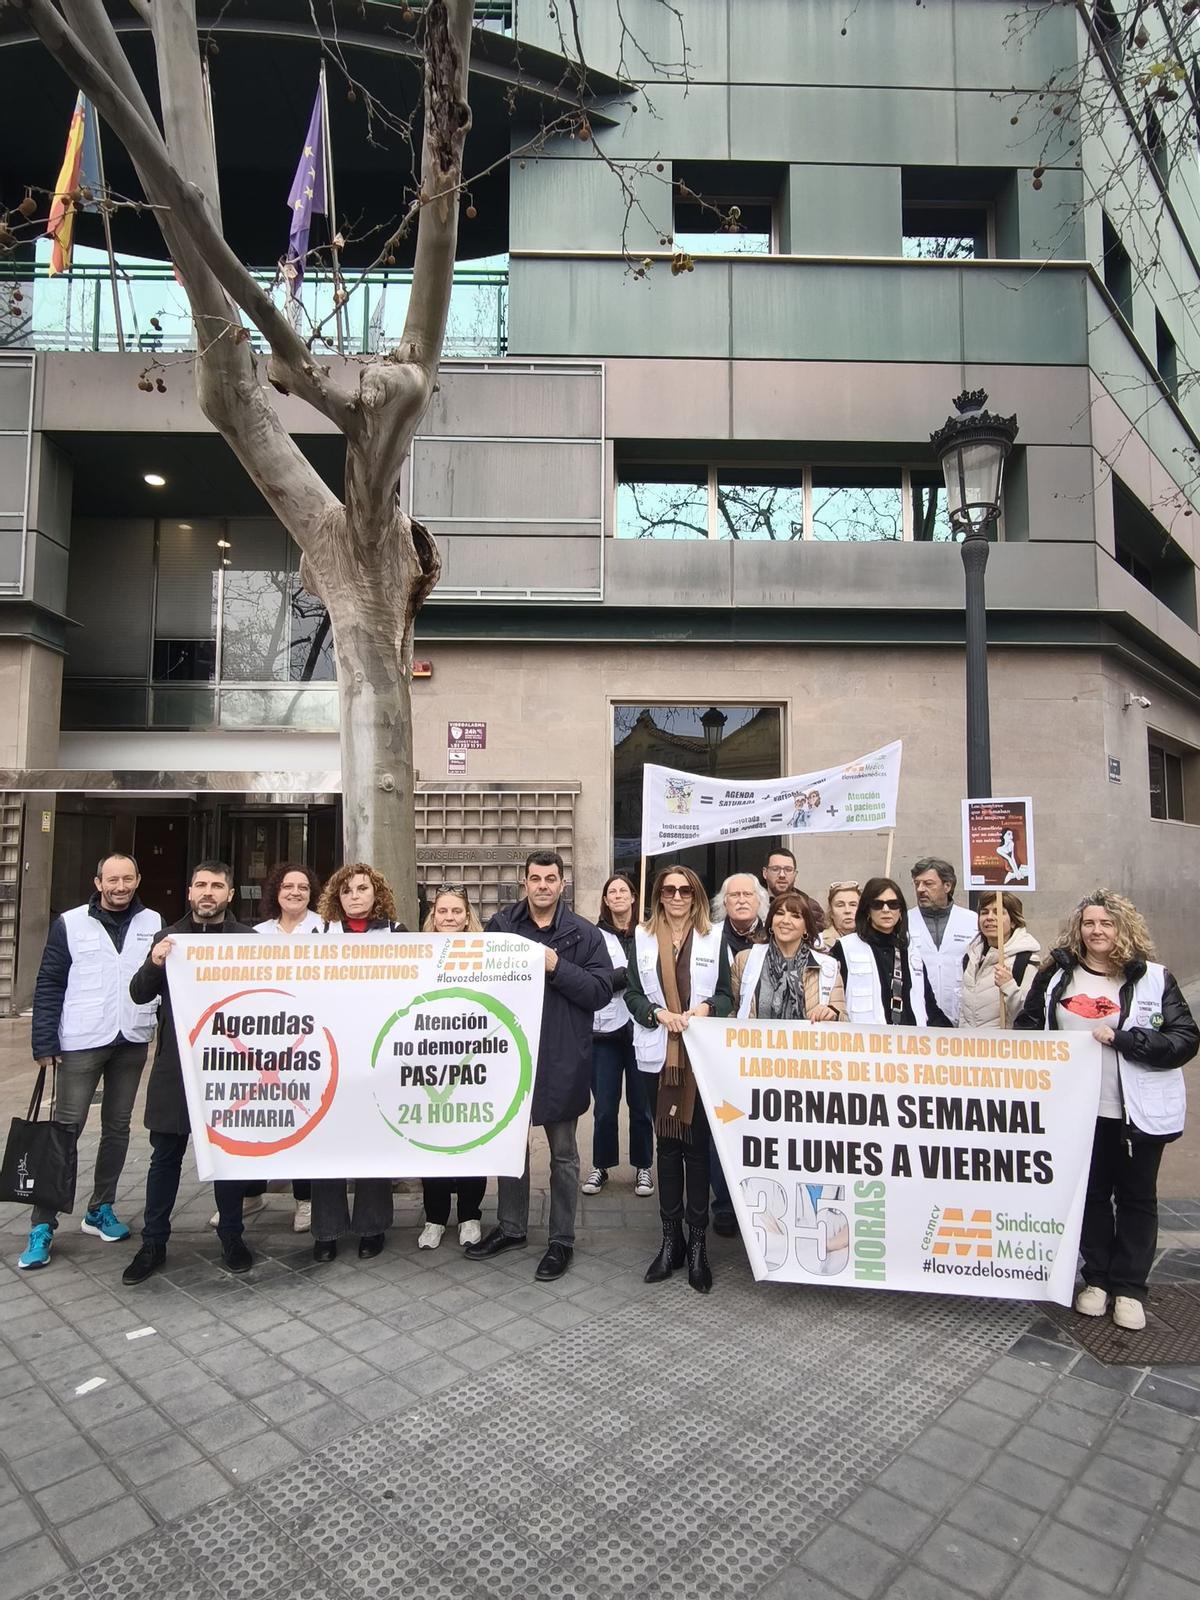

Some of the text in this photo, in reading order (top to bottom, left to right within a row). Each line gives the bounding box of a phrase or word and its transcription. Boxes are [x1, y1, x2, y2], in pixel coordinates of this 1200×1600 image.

[725, 790, 755, 799] AGENDA
[187, 943, 434, 961] POR LA MEJORA DE LAS CONDICIONES
[485, 939, 530, 953] Sindicato
[196, 964, 419, 981] LABORALES DE LOS FACULTATIVOS
[484, 957, 529, 970] Médico
[436, 971, 532, 983] #lavozdelosmédicos
[211, 1011, 315, 1039] Agendas
[414, 1012, 488, 1031] Atención
[393, 1036, 509, 1056] no demorable
[726, 1027, 1071, 1062] POR LA MEJORA DE LAS CONDICIONES
[202, 1047, 321, 1071] ilimitadas
[400, 1063, 487, 1087] PAS/PAC
[739, 1056, 1052, 1090] LABORALES DE LOS FACULTATIVOS
[205, 1078, 311, 1101] EN ATENCIÓN
[211, 1109, 295, 1128] PRIMARIA
[398, 1101, 494, 1124] 24 HORAS
[748, 1088, 1046, 1135] JORNADA SEMANAL
[742, 1135, 1054, 1185] DE LUNES A VIERNES
[739, 1176, 850, 1277] 35
[853, 1179, 887, 1281] HORAS
[920, 1204, 941, 1251] cesmcv
[995, 1211, 1065, 1235] Sindicato
[997, 1239, 1055, 1263] Médic
[922, 1257, 1050, 1282] #lavozdelosmédi
